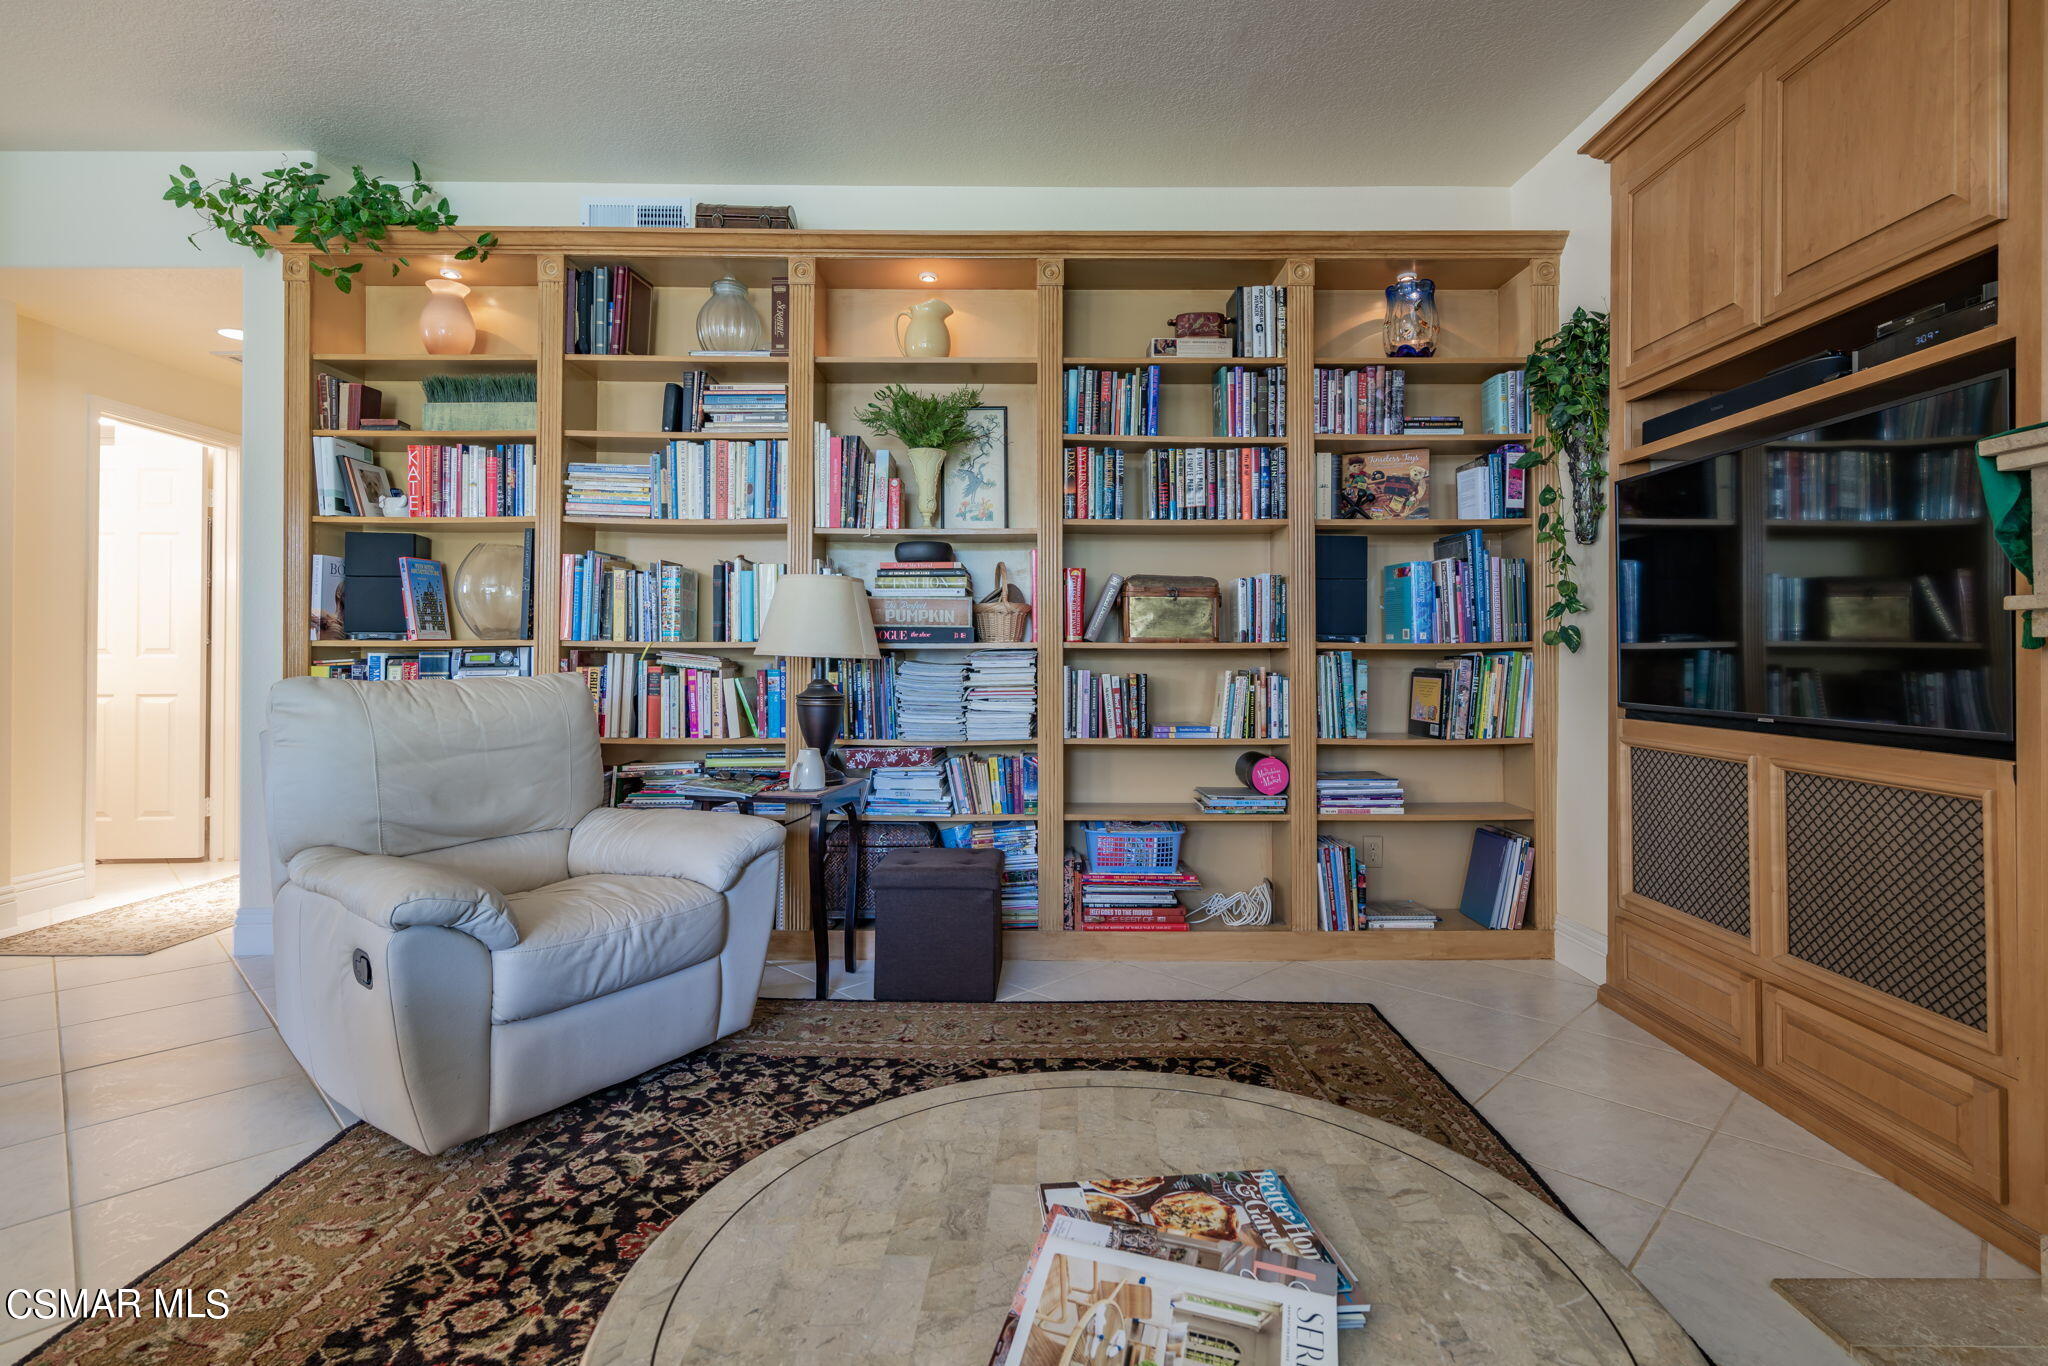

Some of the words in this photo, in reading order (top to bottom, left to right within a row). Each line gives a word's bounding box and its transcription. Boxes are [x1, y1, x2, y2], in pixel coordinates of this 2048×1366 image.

[1067, 451, 1076, 479] DARK
[1079, 448, 1088, 463] MY
[1116, 455, 1124, 478] BILLY
[718, 456, 726, 480] HOUSE
[1079, 463, 1088, 488] TURN
[408, 450, 421, 511] KATE
[718, 480, 726, 501] BOOK
[885, 609, 956, 623] PUMPKIN
[877, 630, 908, 641] OGUE
[1235, 1183, 1261, 1203] &
[1250, 1169, 1296, 1225] Better
[1296, 1306, 1325, 1366] SER
